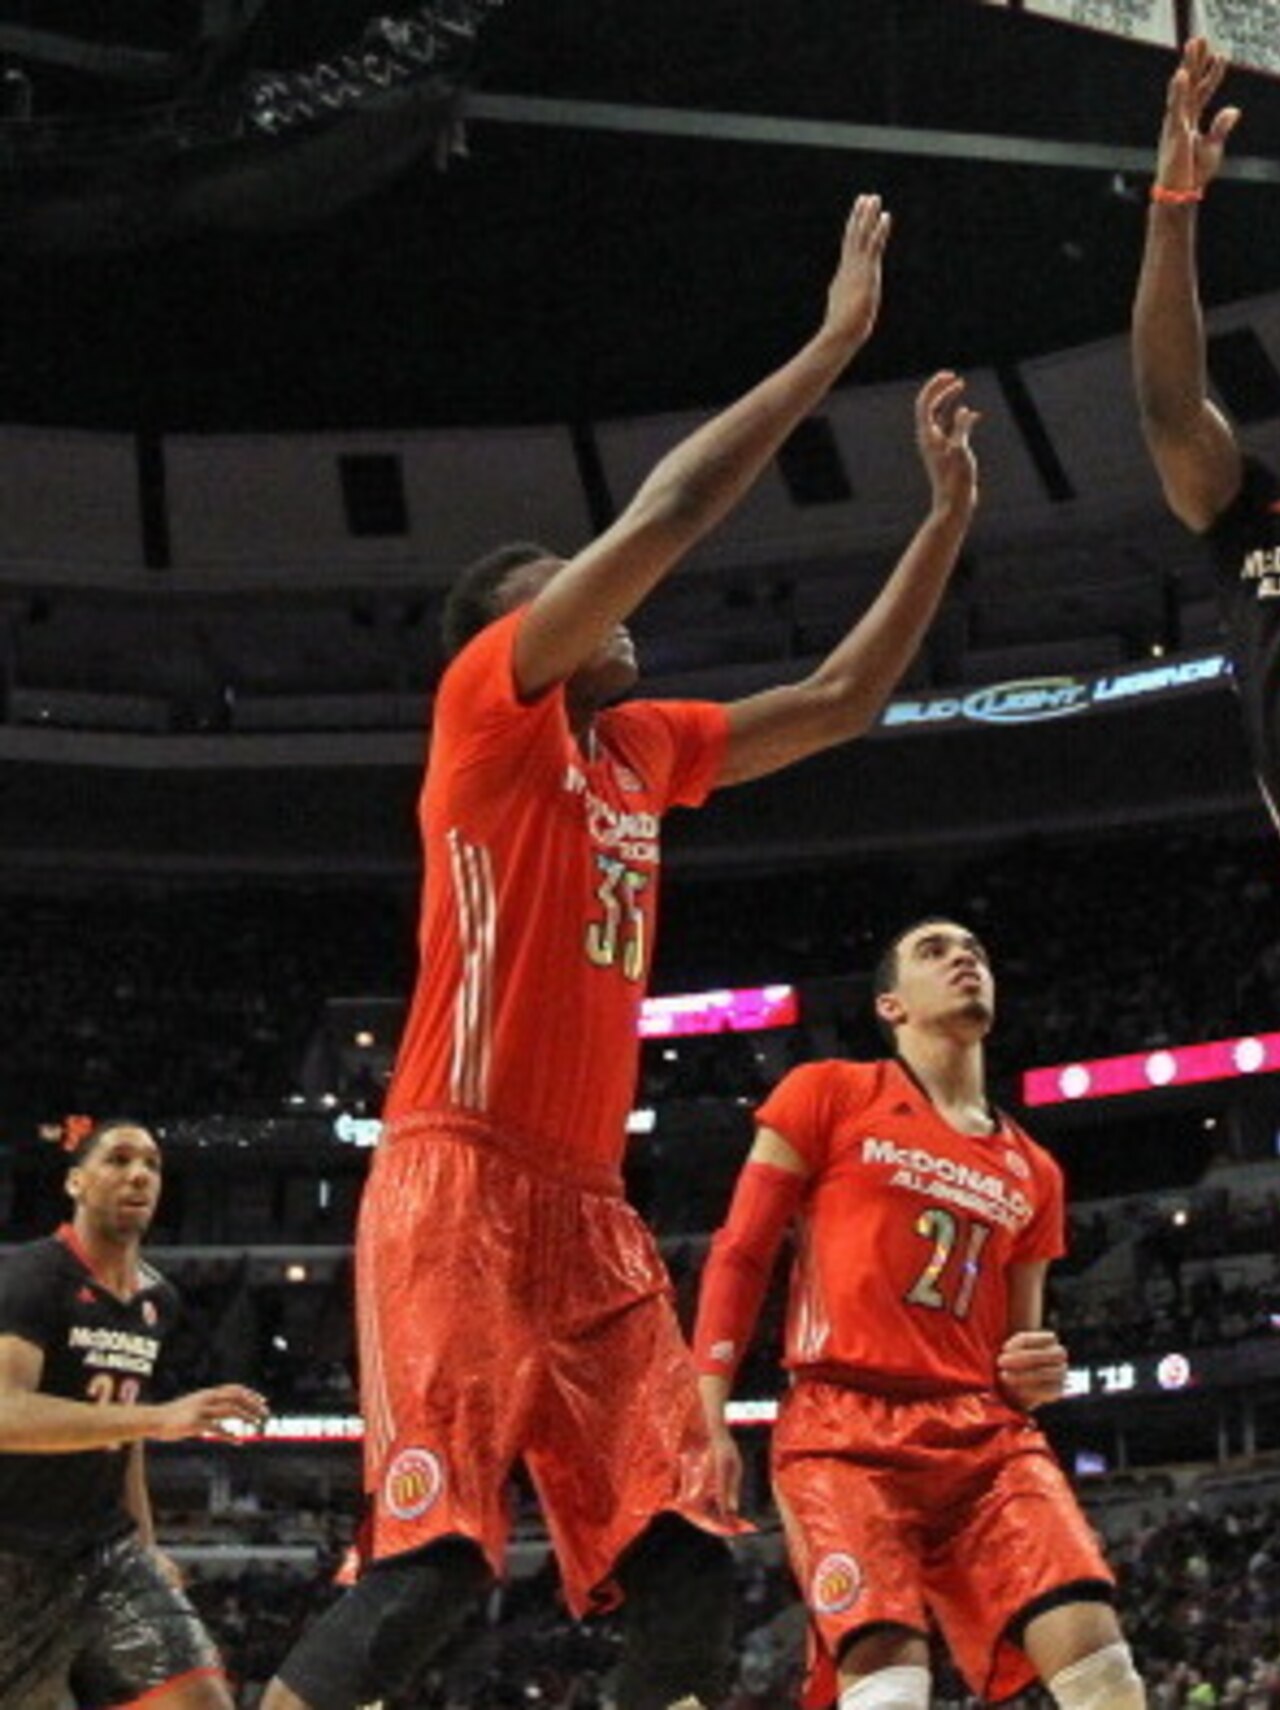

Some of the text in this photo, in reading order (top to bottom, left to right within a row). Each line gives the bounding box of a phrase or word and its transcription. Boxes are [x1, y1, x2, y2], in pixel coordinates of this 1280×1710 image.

[883, 700, 961, 727] BUD
[980, 683, 1088, 714] LIGHT
[585, 853, 649, 983] 35
[903, 1206, 993, 1320] 21
